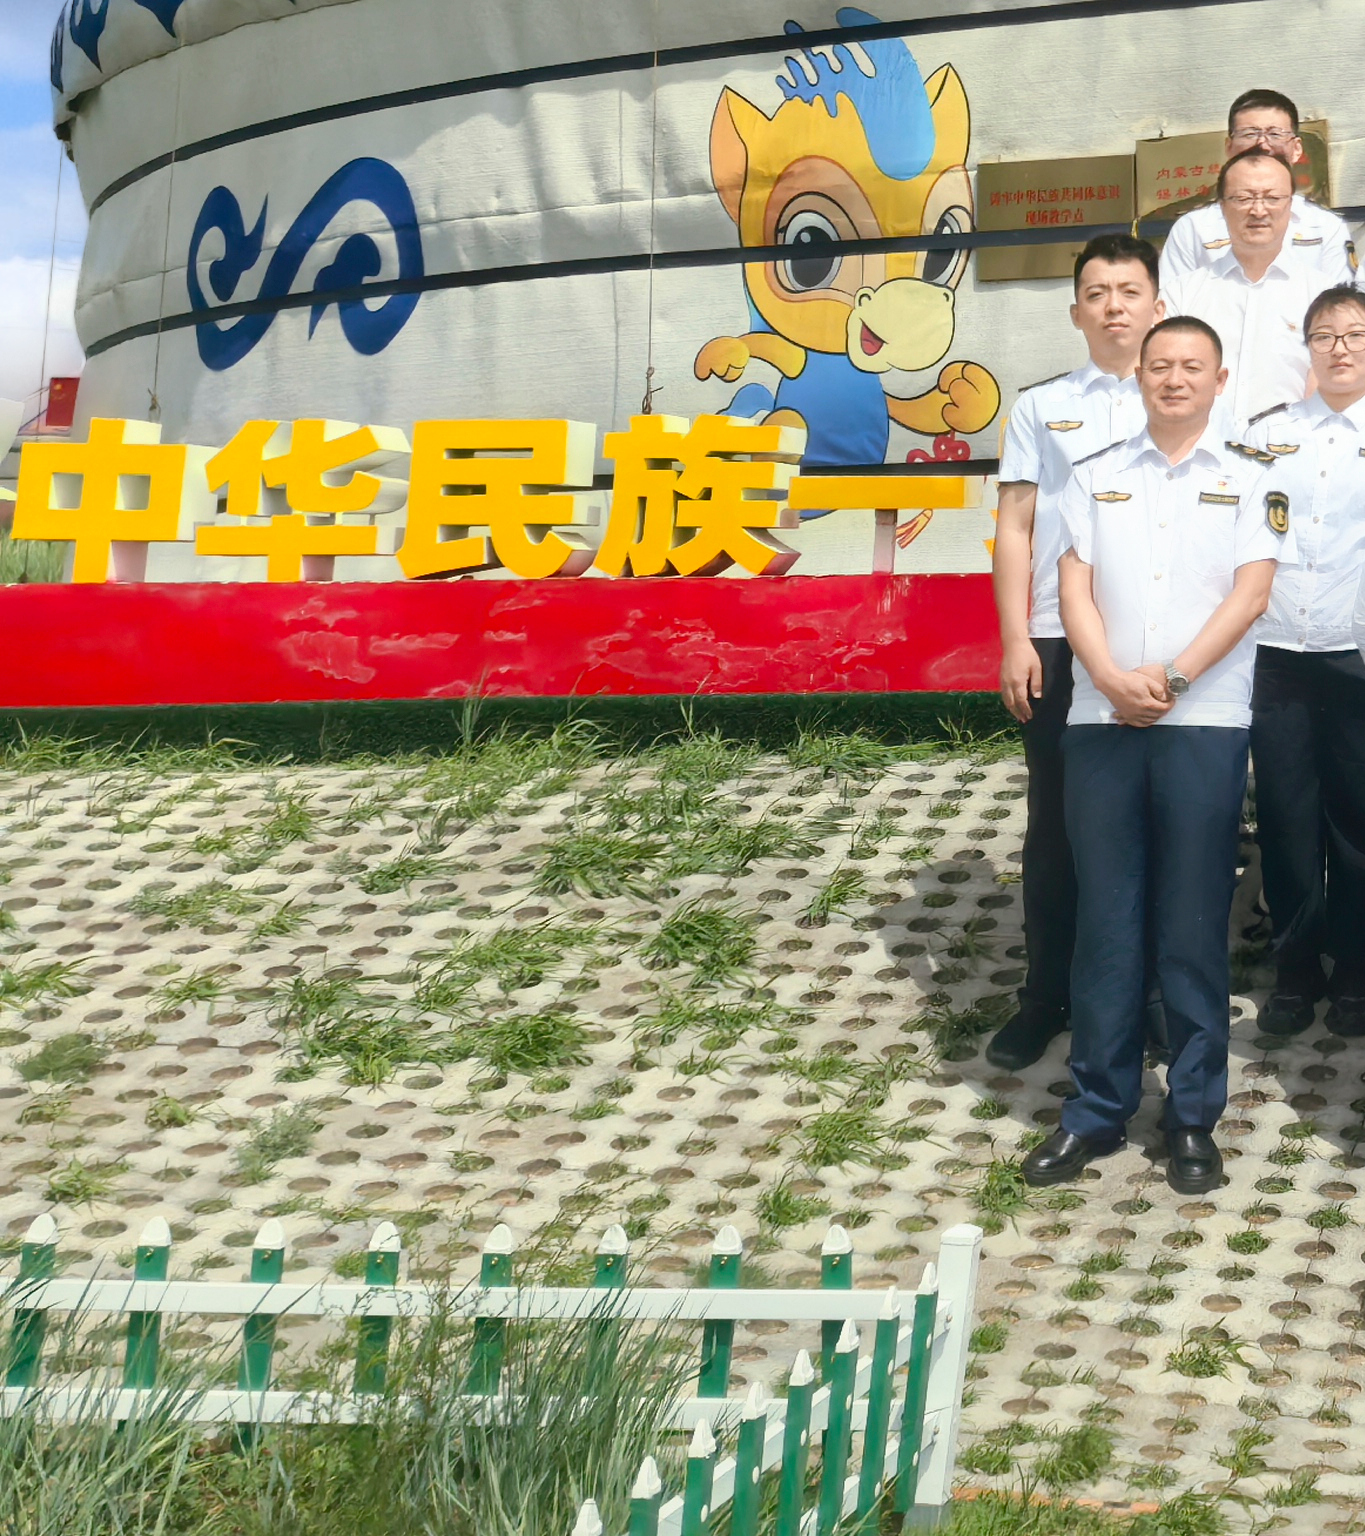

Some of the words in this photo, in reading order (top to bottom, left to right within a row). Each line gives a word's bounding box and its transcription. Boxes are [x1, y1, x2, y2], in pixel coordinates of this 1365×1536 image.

[11, 414, 1005, 584] 中华民族一
